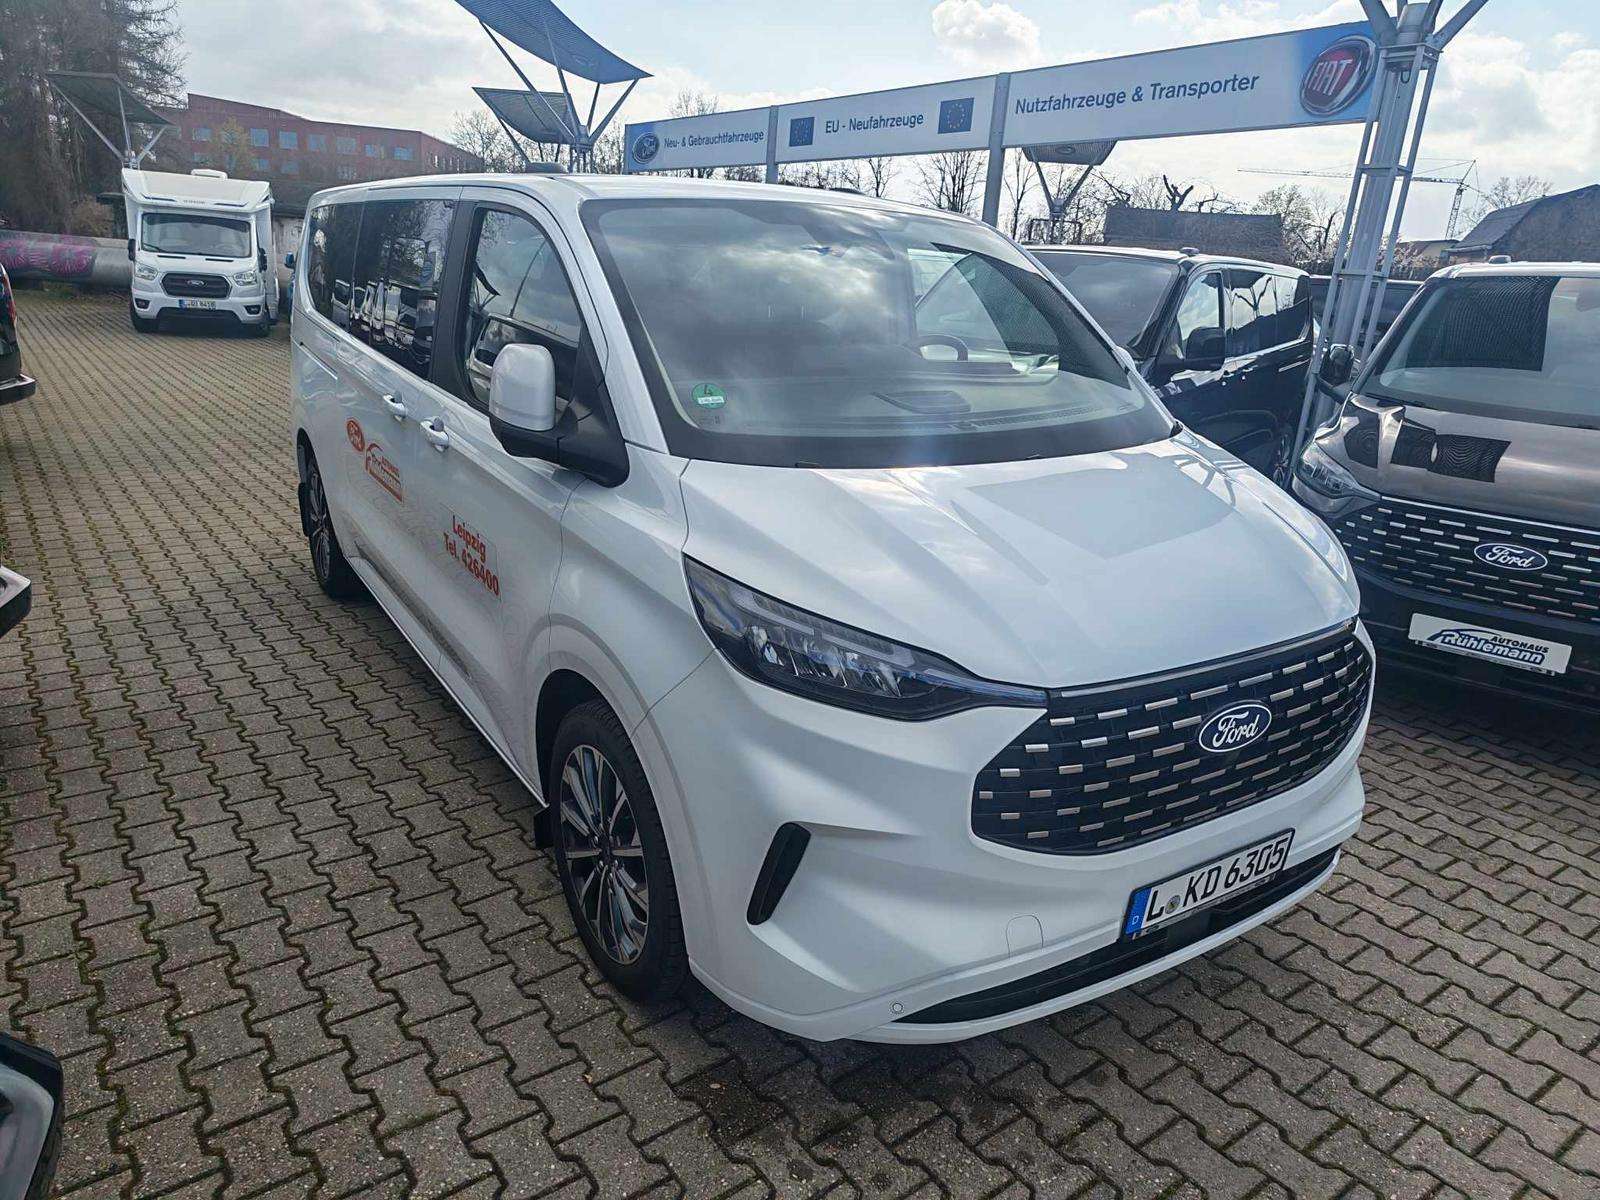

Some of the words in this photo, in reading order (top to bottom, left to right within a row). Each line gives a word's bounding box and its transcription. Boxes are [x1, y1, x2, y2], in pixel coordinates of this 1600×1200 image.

[1015, 89, 1127, 114] Nutzfahrzeuge
[1131, 86, 1143, 102] &
[1150, 74, 1259, 101] Transporter
[1308, 59, 1354, 96] FIAT
[664, 137, 680, 149] Neu-
[681, 137, 687, 147] &
[688, 130, 765, 147] Gebrauchtfahrzeuge
[825, 120, 839, 134] EU
[849, 112, 924, 132] Neufahrzeuge
[443, 531, 460, 561] Tel.
[452, 514, 487, 565] Leipzig
[1484, 545, 1534, 569] Ford
[1438, 631, 1545, 664] Rühlemann
[1490, 635, 1550, 654] AUTOHAUS
[1212, 711, 1260, 749] Ford
[1146, 889, 1165, 922] L
[1182, 865, 1222, 907] KD
[1224, 838, 1289, 889] 6305
